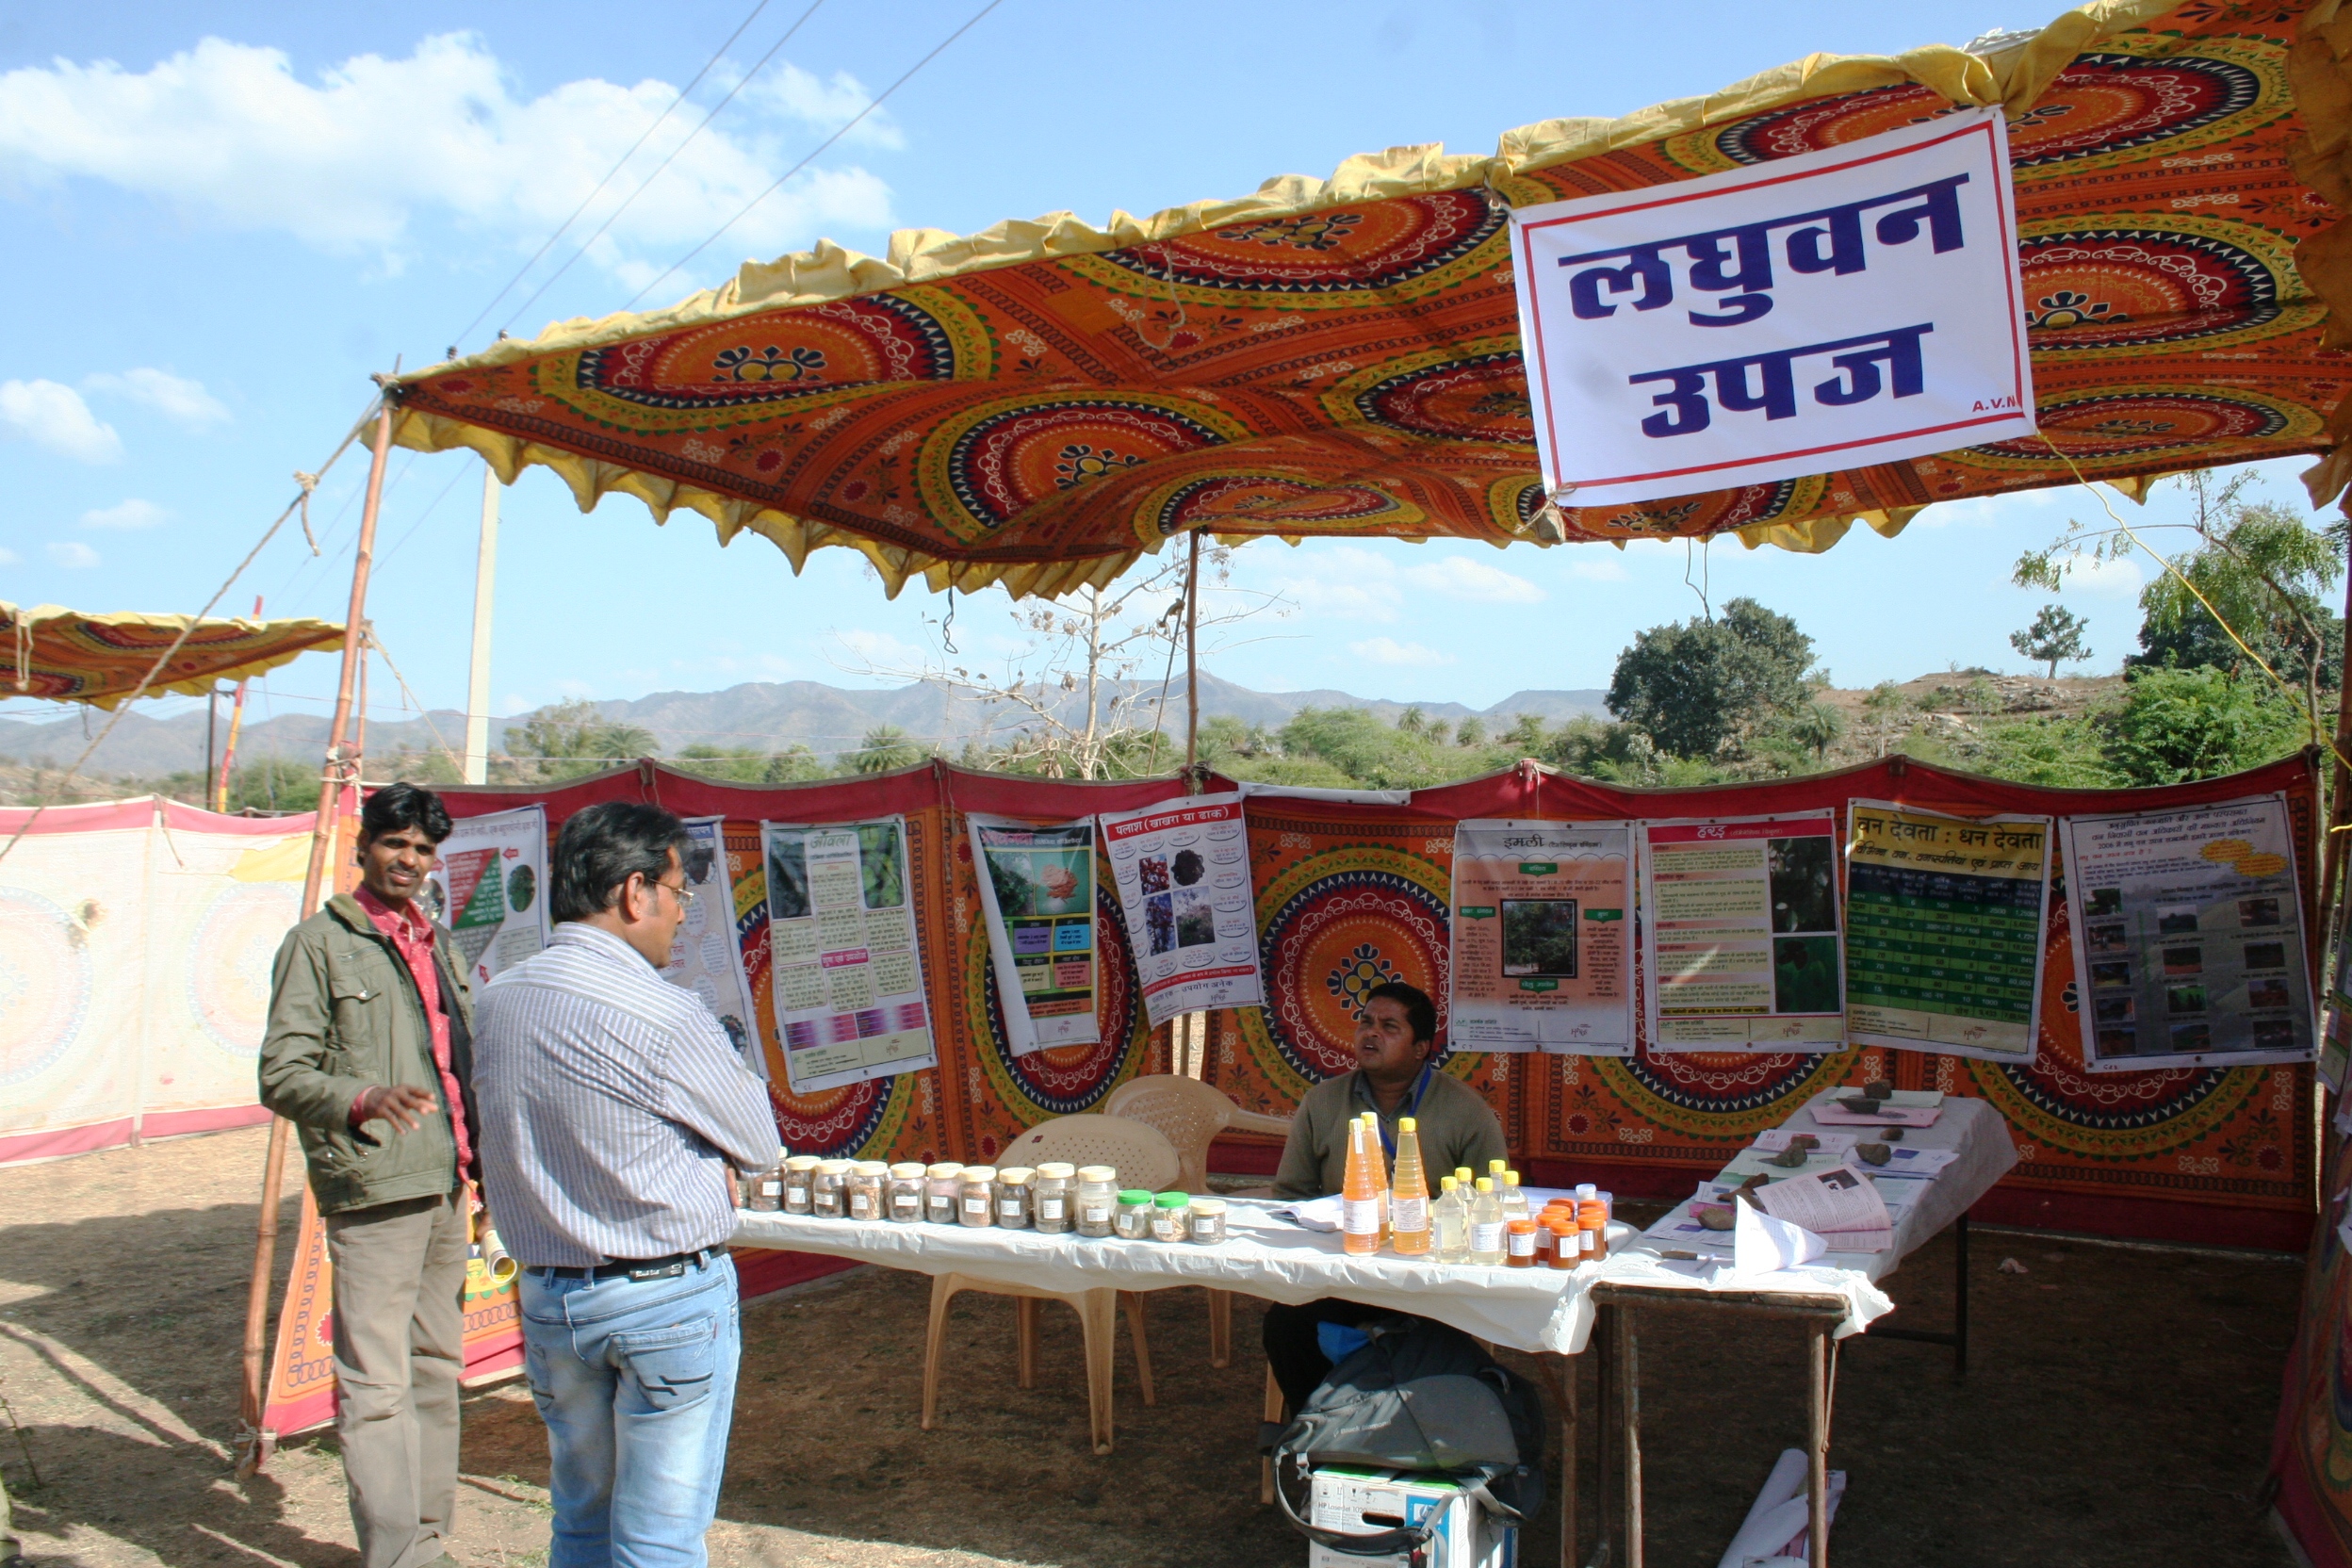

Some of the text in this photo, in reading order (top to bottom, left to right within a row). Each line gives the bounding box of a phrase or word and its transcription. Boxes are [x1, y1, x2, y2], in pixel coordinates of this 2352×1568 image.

[1558, 172, 1969, 327] लघुवन
[1628, 322, 1934, 438] उपज
[1115, 820, 1142, 835] पलाश
[1182, 812, 1196, 822] या
[1697, 825, 1728, 839] हरड़
[1857, 816, 1884, 835] वन
[1890, 814, 1937, 841] देवता
[1960, 829, 1988, 846] धन
[1994, 825, 2042, 851] देवता
[1502, 833, 1545, 850] इमली
[1181, 982, 1209, 992] उपयोग
[1212, 979, 1233, 988] अनेक
